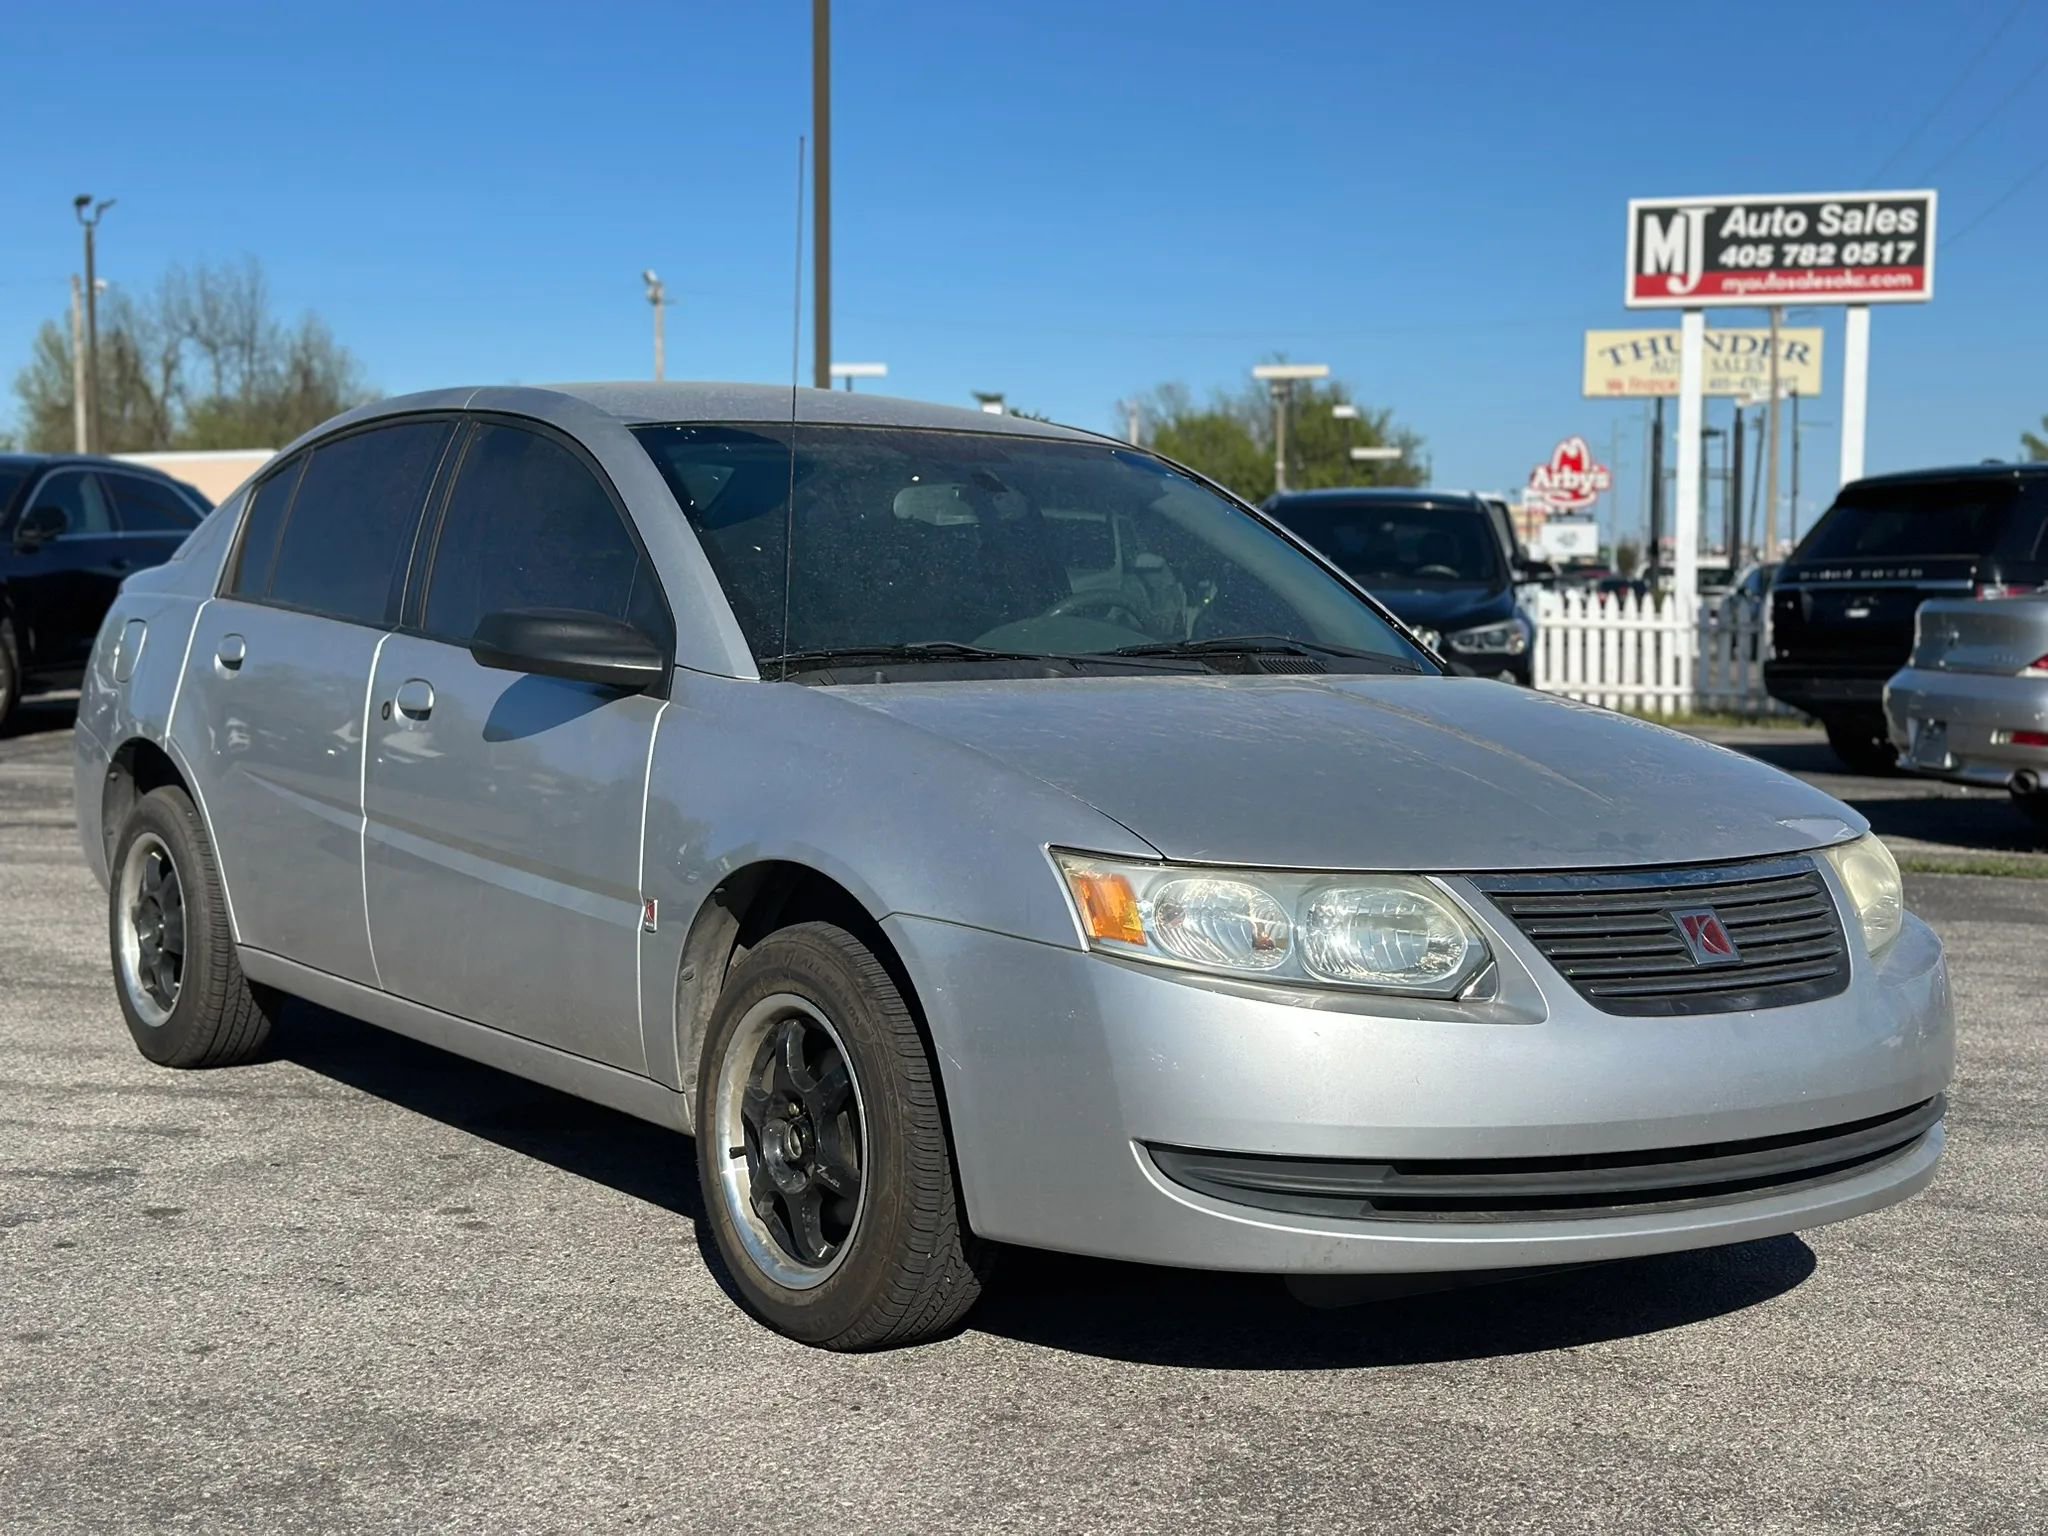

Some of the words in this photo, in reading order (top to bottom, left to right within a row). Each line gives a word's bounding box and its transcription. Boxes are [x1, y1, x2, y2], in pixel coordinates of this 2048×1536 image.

[1720, 206, 1808, 239] Auto
[1817, 203, 1918, 236] Sales
[1643, 207, 1715, 295] MJ
[1719, 244, 1775, 268] 405
[1782, 242, 1838, 267] 782
[1841, 240, 1917, 265] 0517
[1531, 464, 1610, 497] Arby's
